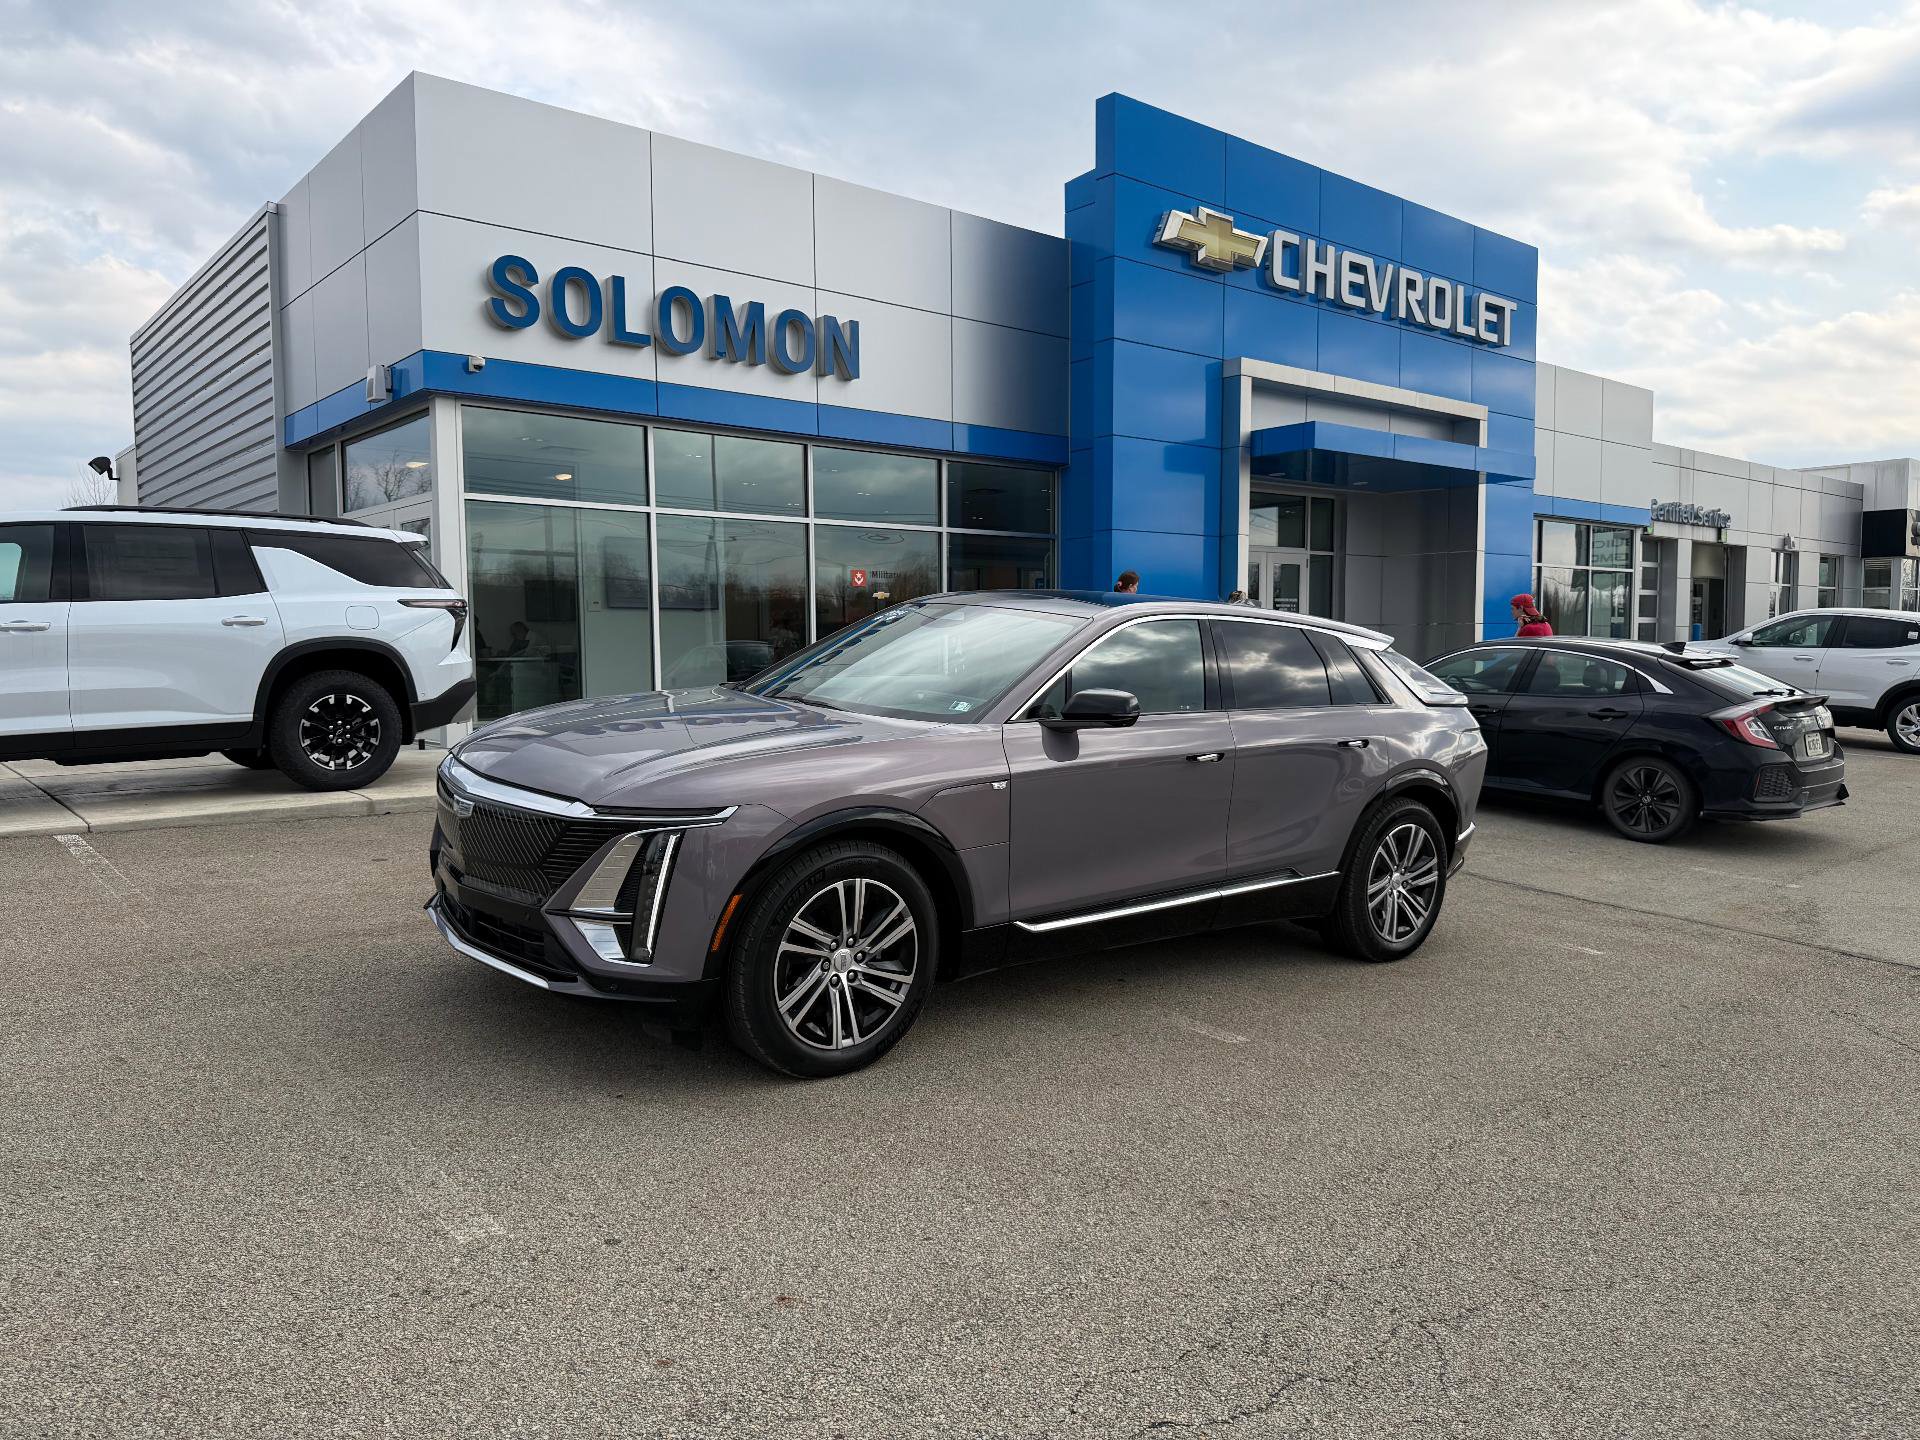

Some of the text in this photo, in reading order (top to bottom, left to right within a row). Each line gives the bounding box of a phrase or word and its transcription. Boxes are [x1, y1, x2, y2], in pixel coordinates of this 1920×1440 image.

[485, 254, 860, 381] SOLOMON
[1266, 229, 1517, 347] CHEVROLET
[1651, 499, 1731, 528] Certified Service
